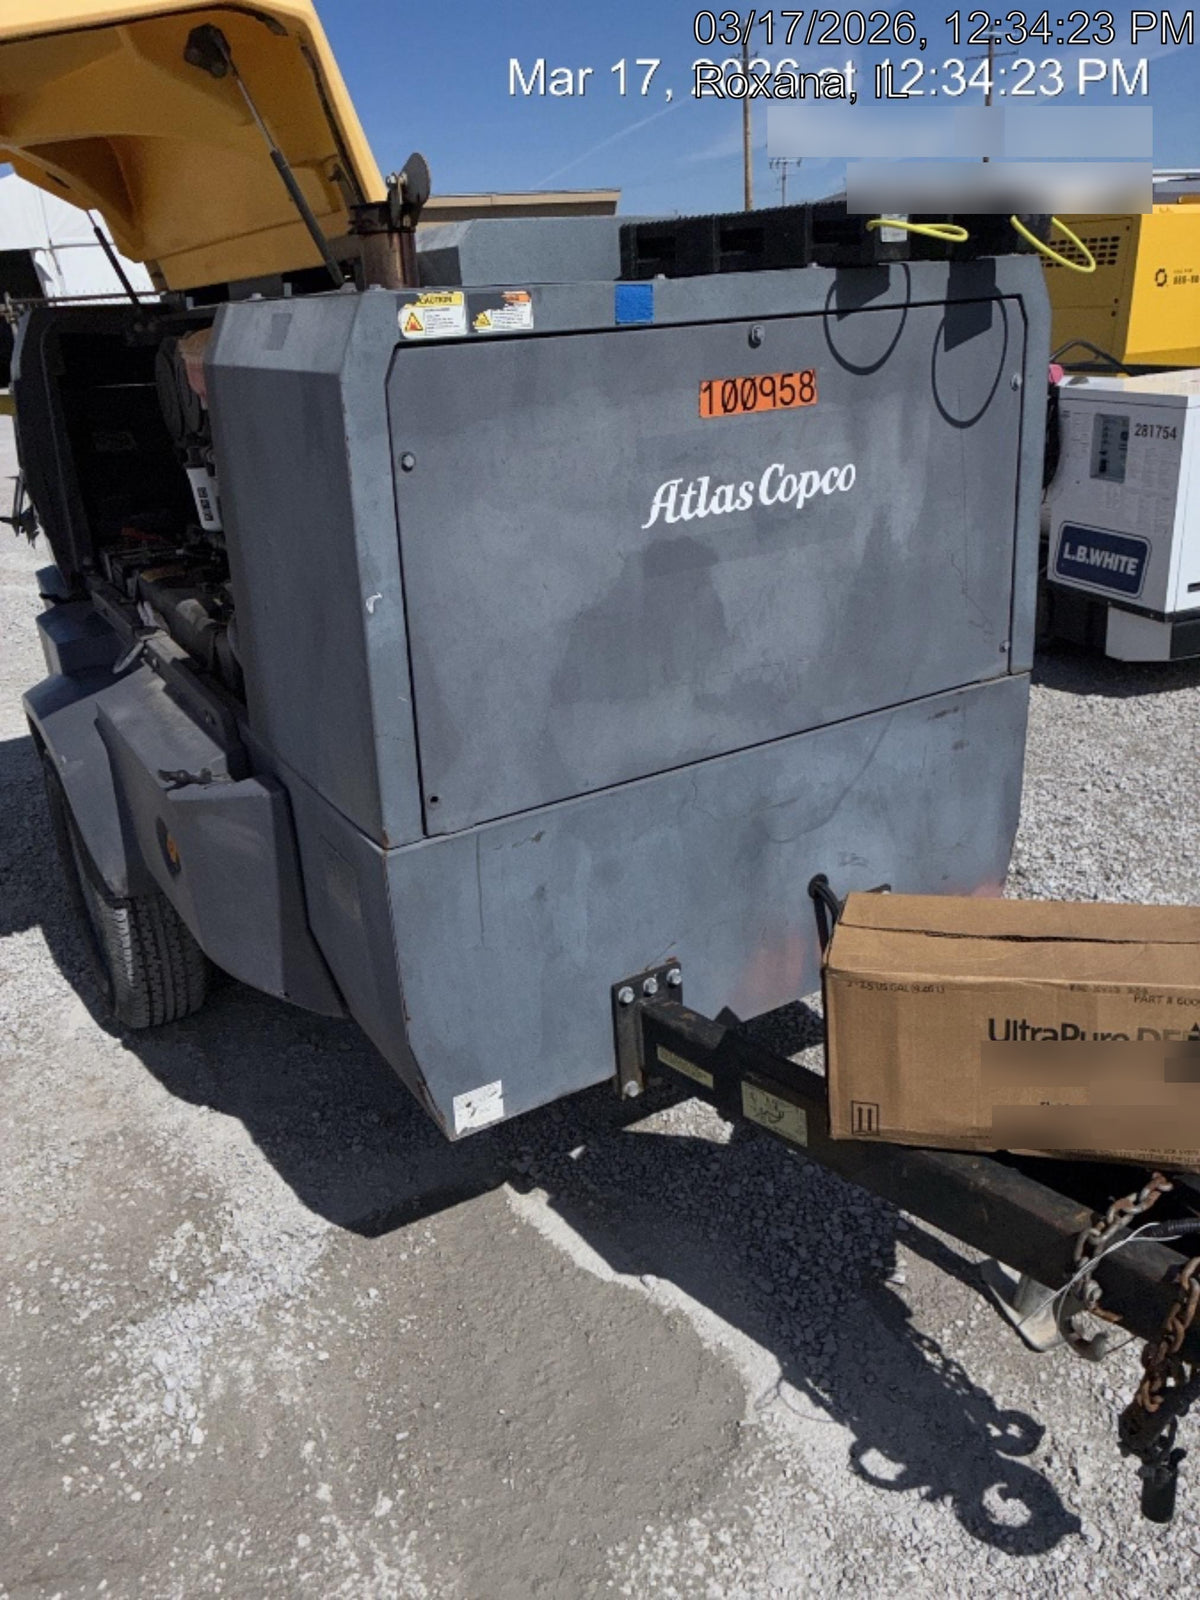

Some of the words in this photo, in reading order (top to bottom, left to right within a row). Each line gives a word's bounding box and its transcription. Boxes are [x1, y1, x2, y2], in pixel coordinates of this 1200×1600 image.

[701, 370, 816, 415] 100958
[1134, 422, 1177, 440] 281754
[641, 476, 754, 529] Atlas
[759, 463, 856, 509] Copco
